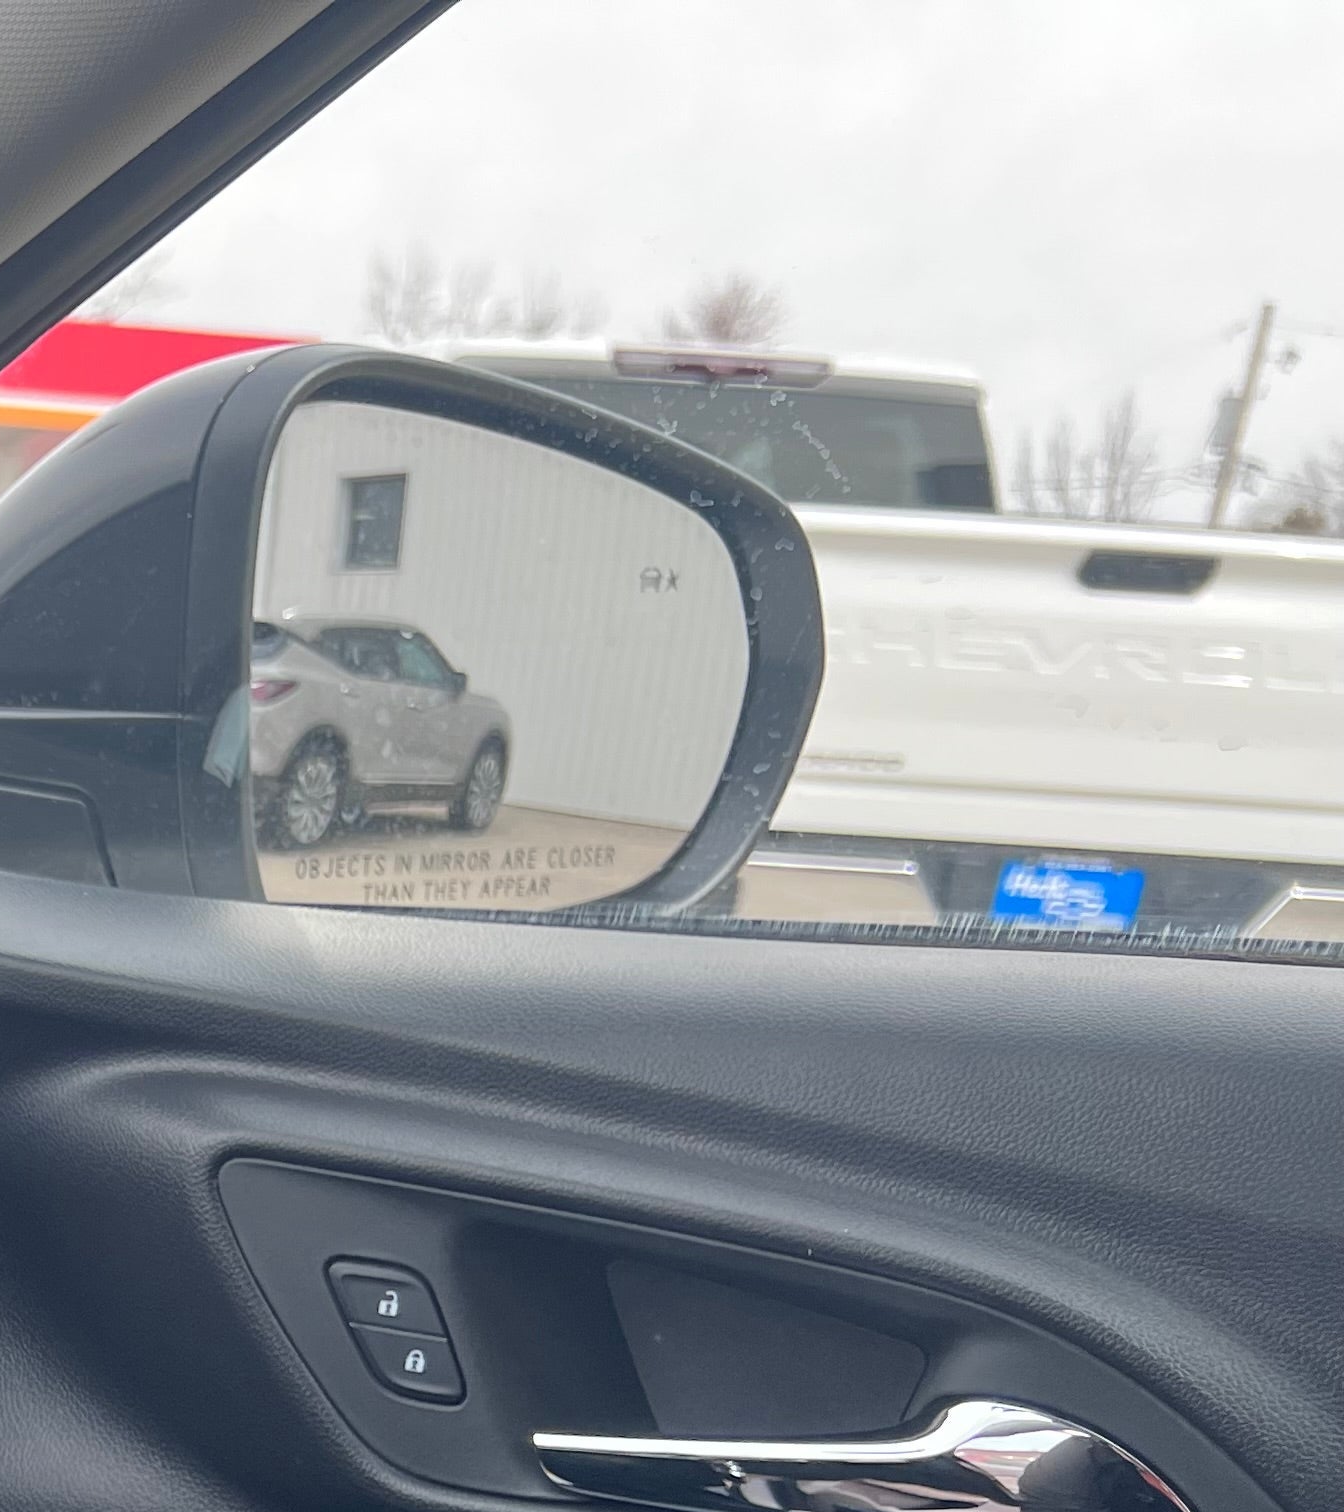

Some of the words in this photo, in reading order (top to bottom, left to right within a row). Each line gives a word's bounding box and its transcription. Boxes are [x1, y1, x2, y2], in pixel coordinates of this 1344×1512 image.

[827, 624, 1344, 695] HEVROL
[295, 853, 385, 881] OBJECTS
[394, 853, 411, 875] IN
[419, 850, 492, 875] MIRROR
[500, 848, 537, 871] ARE
[546, 846, 616, 869] CLOSER
[363, 882, 413, 904] THAN
[423, 877, 472, 901] THEY
[481, 876, 551, 899] APPEAR
